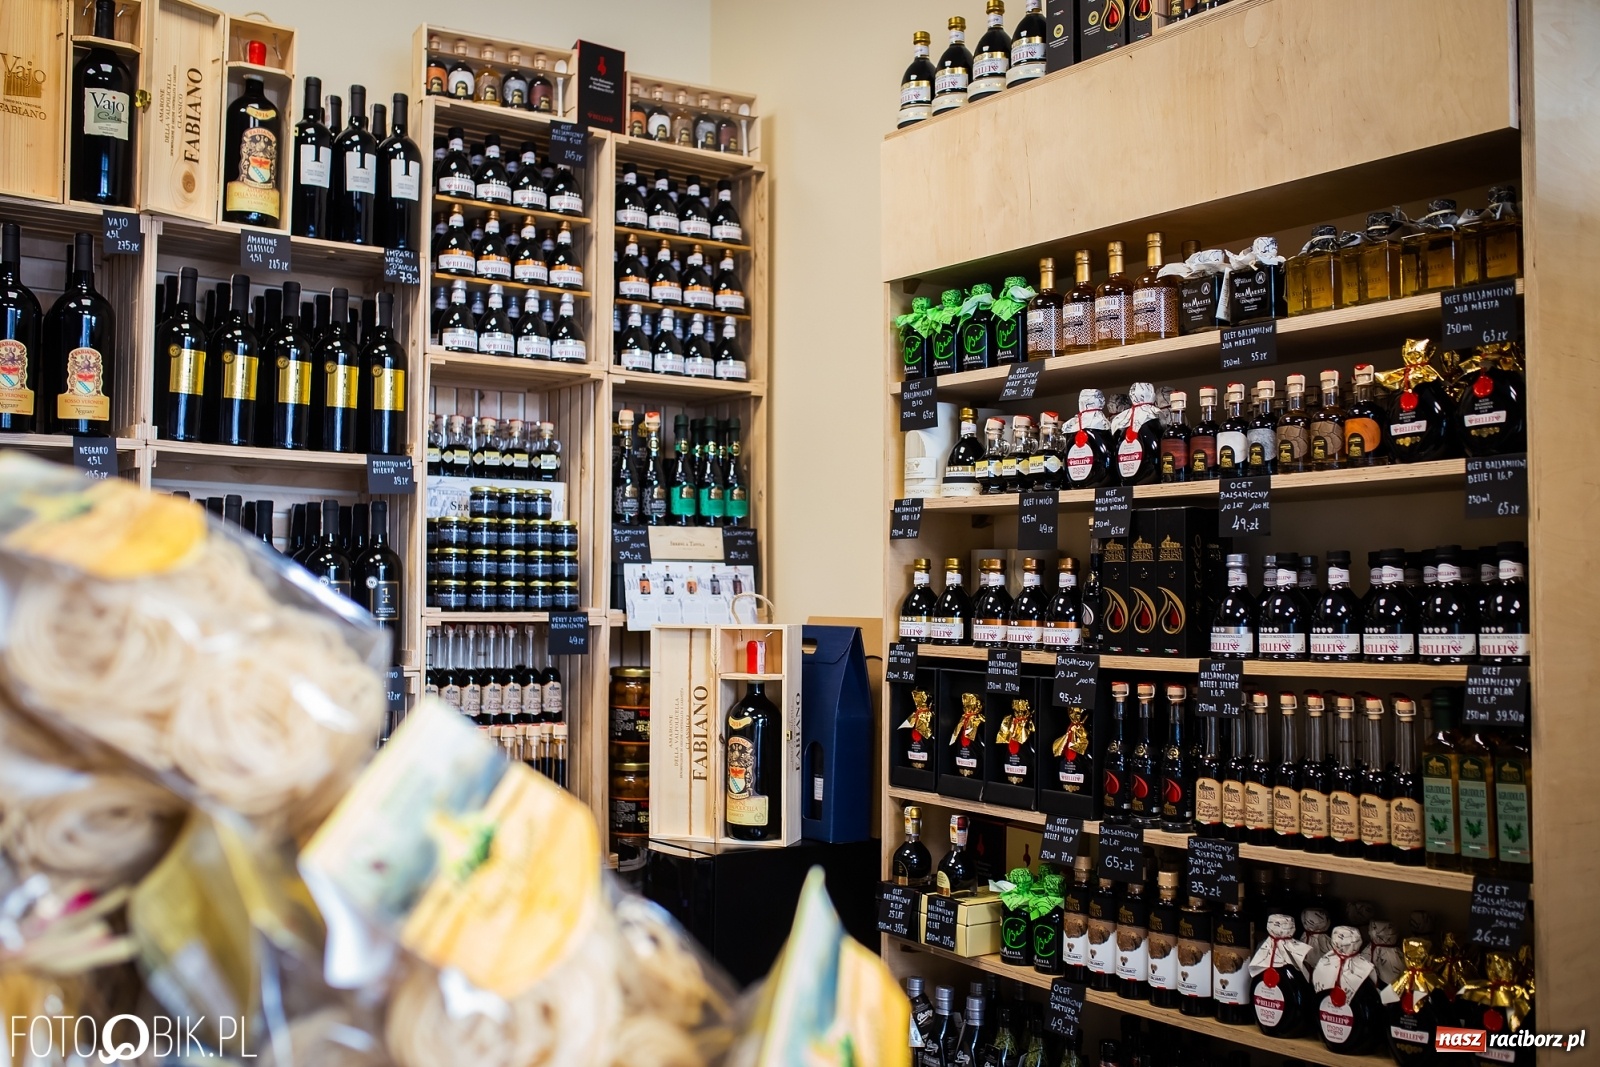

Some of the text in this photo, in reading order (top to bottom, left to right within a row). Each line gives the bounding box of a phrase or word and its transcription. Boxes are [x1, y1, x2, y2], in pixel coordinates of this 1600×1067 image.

[0, 52, 46, 88] Vajo
[90, 92, 125, 114] Vajo
[0, 103, 47, 120] FABIANO
[184, 67, 203, 164] FABIANO
[107, 217, 128, 230] VAJO
[247, 234, 277, 246] AMARONE
[246, 244, 274, 254] CLASSICO
[1444, 287, 1514, 305] OCET BALSAMICZNY
[1454, 300, 1500, 314] SUA MAESTA
[1224, 325, 1273, 340] OCET BALSAMICZNY
[1483, 329, 1495, 343] 63
[1222, 340, 1232, 350] SUA
[1251, 352, 1259, 361] 55
[79, 446, 108, 455] NEGRARO
[1467, 461, 1482, 471] OCET
[1039, 497, 1053, 505] MIÓD
[1498, 501, 1509, 515] 65
[1211, 663, 1226, 671] OCET
[1482, 666, 1501, 675] OCET
[1200, 672, 1239, 681] BALSAMICZNY
[1219, 681, 1239, 689] SILVER
[1468, 678, 1521, 687] BALSAMICZNY
[693, 684, 709, 782] FABIANO
[1477, 884, 1509, 896] OCET
[1054, 984, 1072, 995] OCET
[1326, 1014, 1344, 1023] BELLEI
